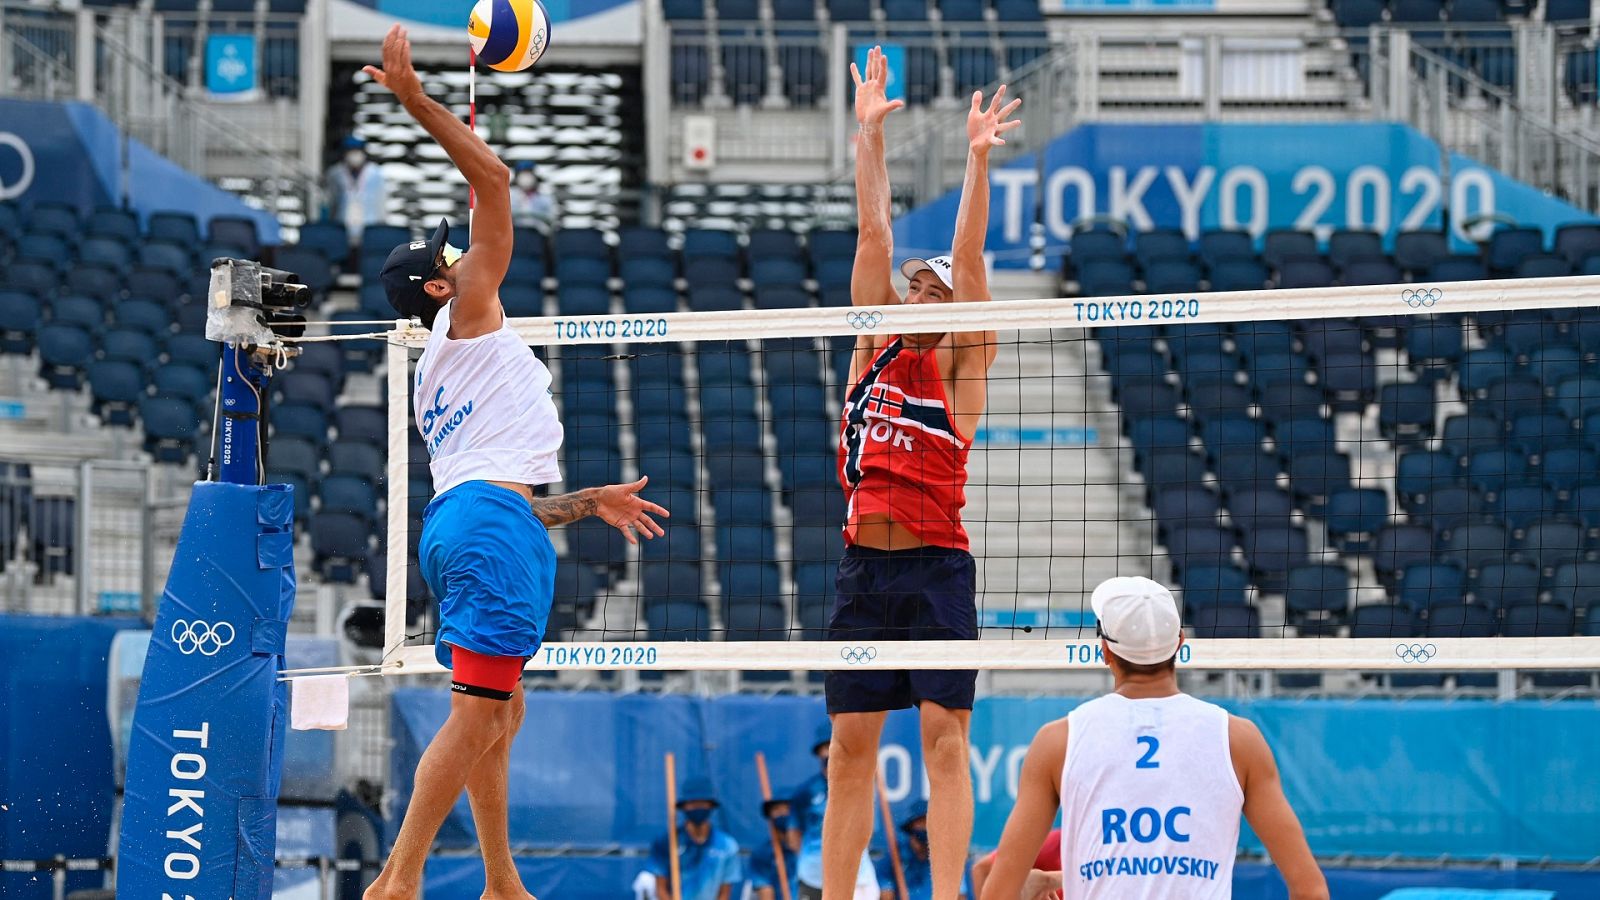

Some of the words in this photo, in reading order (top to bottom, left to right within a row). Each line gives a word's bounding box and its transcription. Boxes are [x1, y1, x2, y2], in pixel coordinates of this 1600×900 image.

[990, 166, 1270, 244] TOKYO
[1291, 165, 1496, 243] 2020
[929, 258, 952, 270] OR
[1073, 301, 1143, 322] TOKYO
[1148, 298, 1199, 319] 2020
[553, 320, 617, 339] TOKYO
[621, 318, 667, 338] 2020
[423, 386, 449, 436] OC
[224, 417, 233, 444] TOKYO
[223, 444, 232, 465] 2020
[544, 646, 606, 665] TOKYO
[610, 646, 657, 665] 2020
[1065, 644, 1106, 663] TOK
[1135, 735, 1161, 769] 2
[163, 722, 209, 880] TOKYO
[1102, 806, 1191, 845] ROC
[1080, 856, 1219, 881] STOYANOVSKIY
